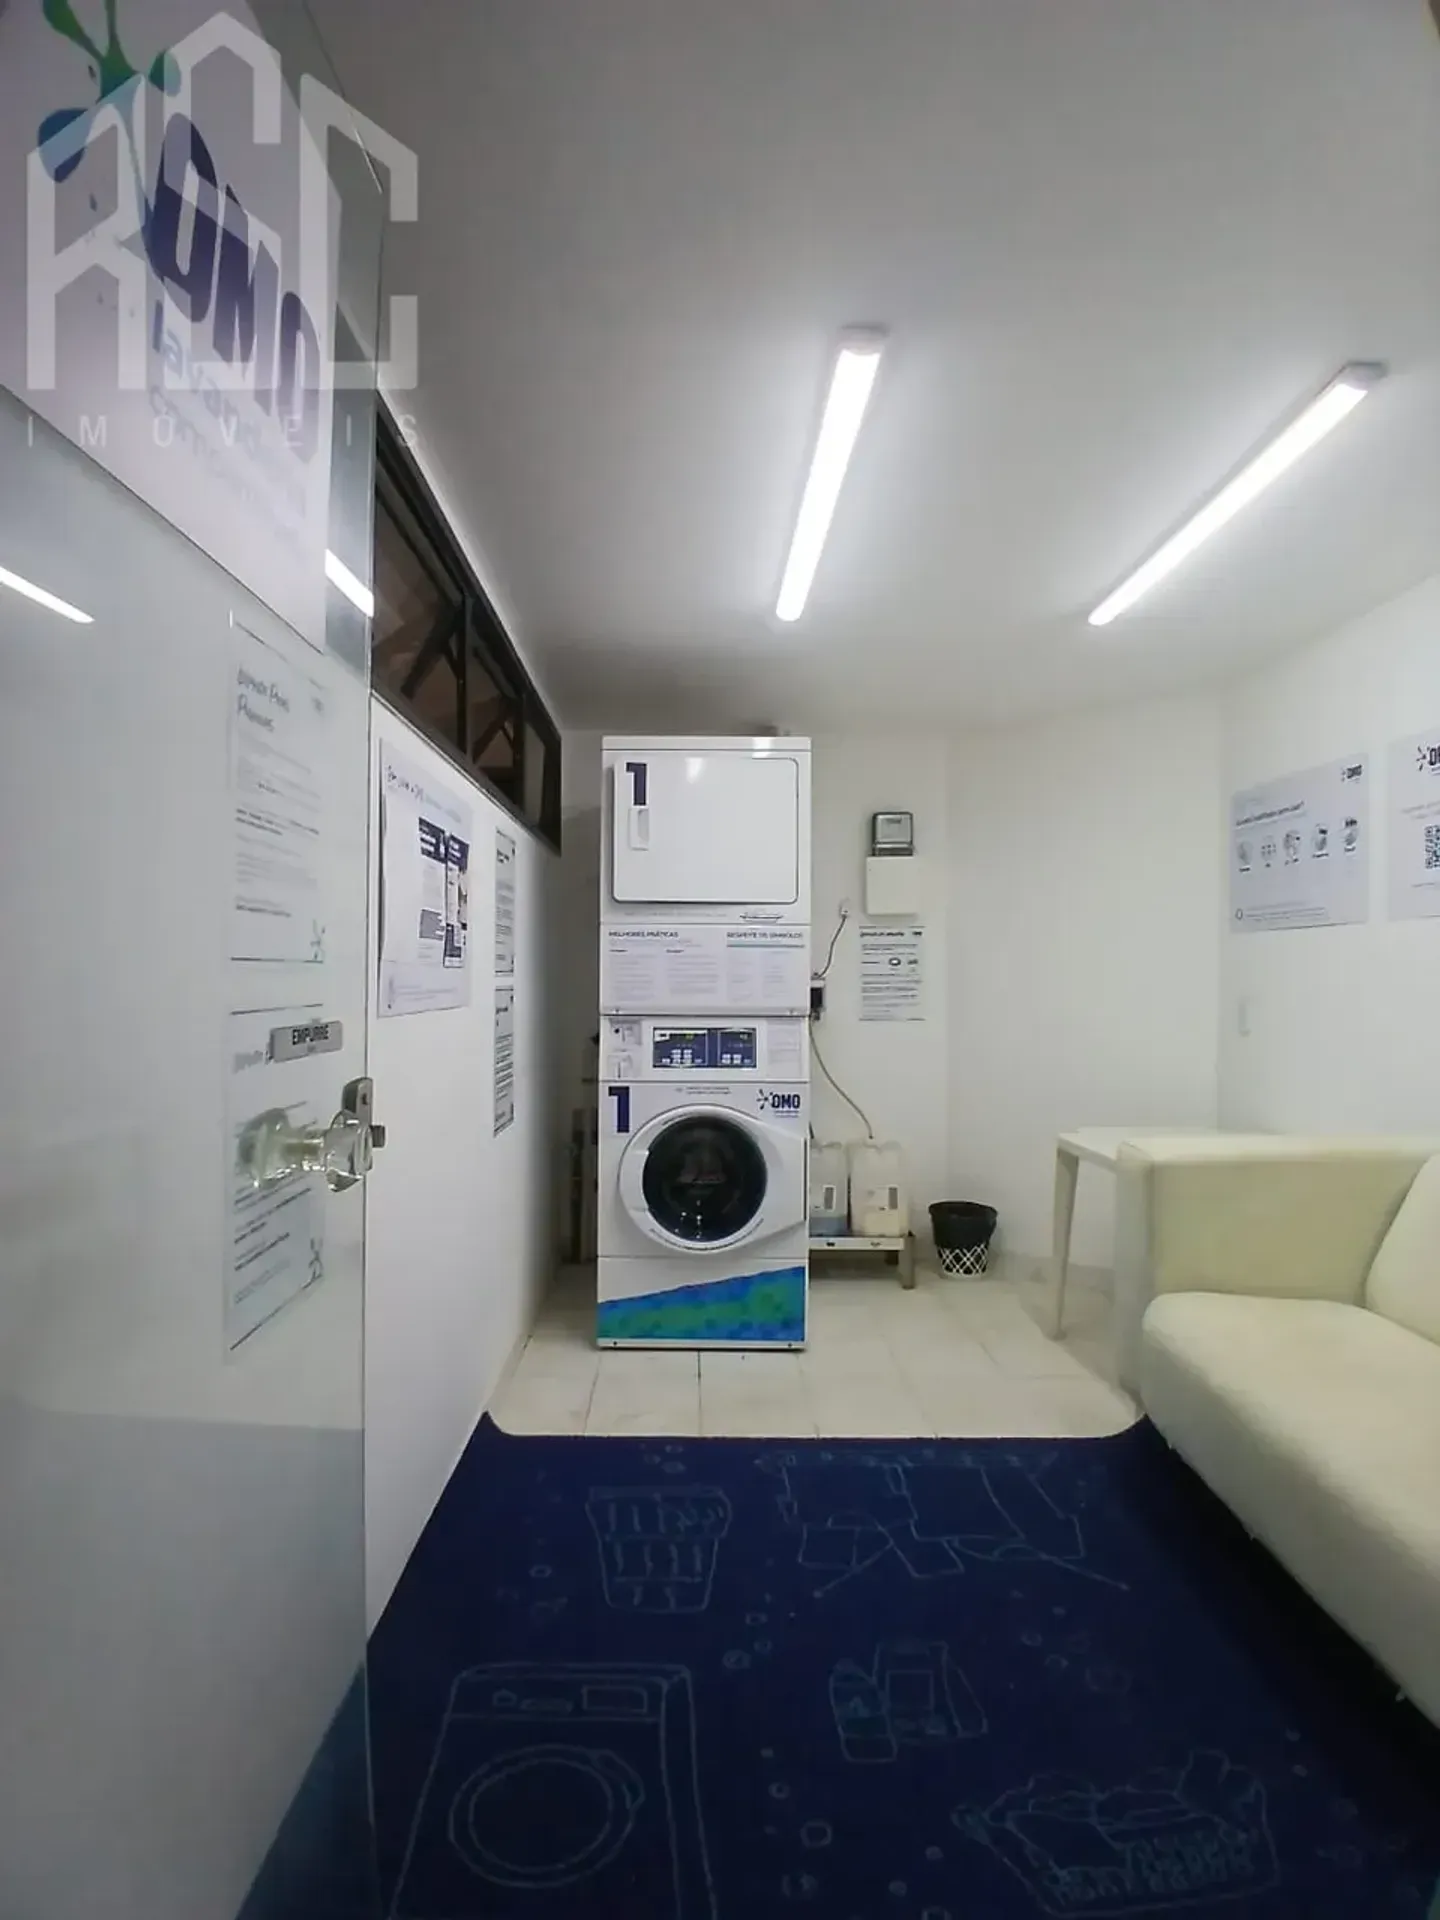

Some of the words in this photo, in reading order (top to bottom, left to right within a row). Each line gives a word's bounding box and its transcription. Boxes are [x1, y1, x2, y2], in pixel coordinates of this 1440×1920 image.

[626, 762, 647, 806] 1
[608, 1086, 630, 1133] 1
[771, 1094, 801, 1109] OMO
